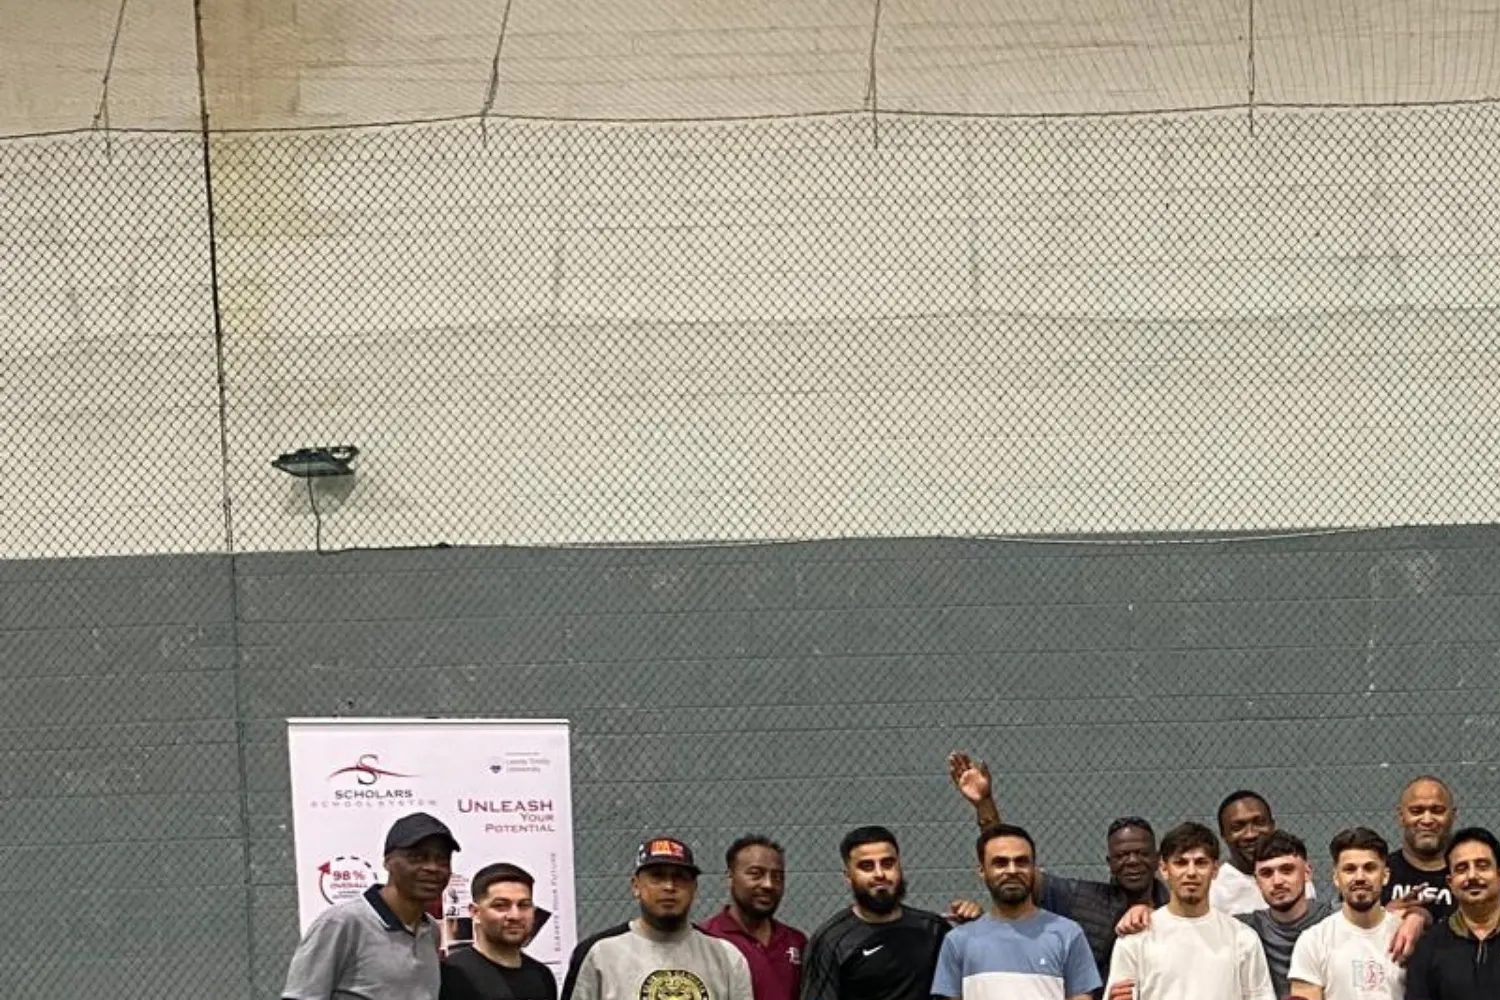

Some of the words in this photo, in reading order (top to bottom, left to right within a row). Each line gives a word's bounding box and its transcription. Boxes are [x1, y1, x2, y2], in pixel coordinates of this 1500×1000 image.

[334, 789, 414, 800] SCHOLARS
[457, 798, 553, 813] UNLEASH
[520, 812, 555, 823] YOUR
[484, 823, 556, 834] POTENTIAL
